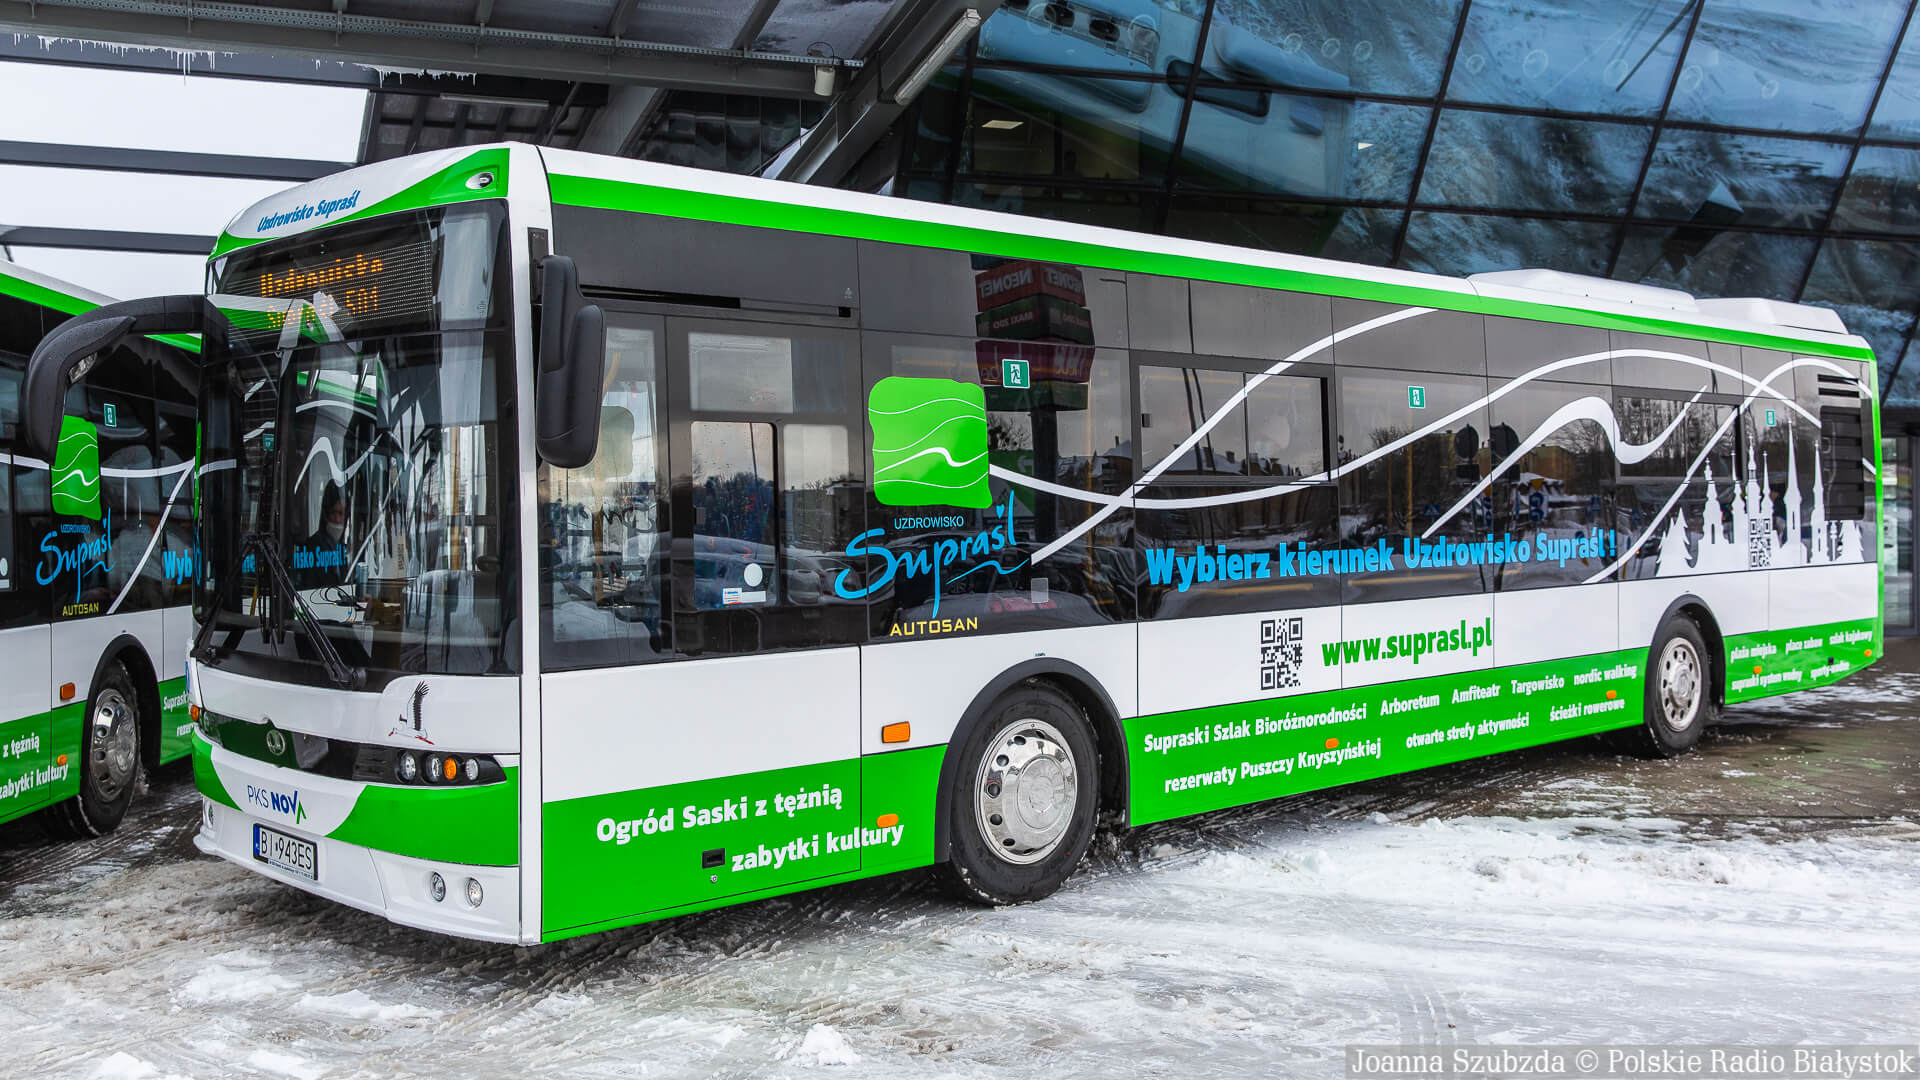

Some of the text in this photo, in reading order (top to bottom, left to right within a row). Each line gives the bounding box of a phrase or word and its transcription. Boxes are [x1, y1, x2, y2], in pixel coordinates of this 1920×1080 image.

[257, 189, 361, 232] Uzdrowisko Supraśl
[894, 516, 964, 529] UZDROWISKO
[1146, 545, 1271, 592] Wybierz
[1279, 538, 1395, 577] kierunek
[1403, 533, 1531, 569] Uzdrowisko
[62, 603, 100, 616] AUTOSAN
[889, 616, 979, 637] AUTOSAN
[1321, 617, 1493, 665] www.suprasl.pl
[1144, 664, 1637, 754] Supraski Szlak Bioróżnorodności Arboretum Amfiteatr Targowisko nordic walking
[11, 731, 40, 759] tężnią
[1164, 699, 1625, 793] rezerwaty Puszczy Knyszyńskiej otwarte strefy aktywności ścieżki rowerowe
[36, 763, 69, 787] kultury
[247, 784, 269, 809] PKS
[596, 784, 842, 846] Ogród Saski z tężnią
[731, 824, 904, 872] zabytki kultury
